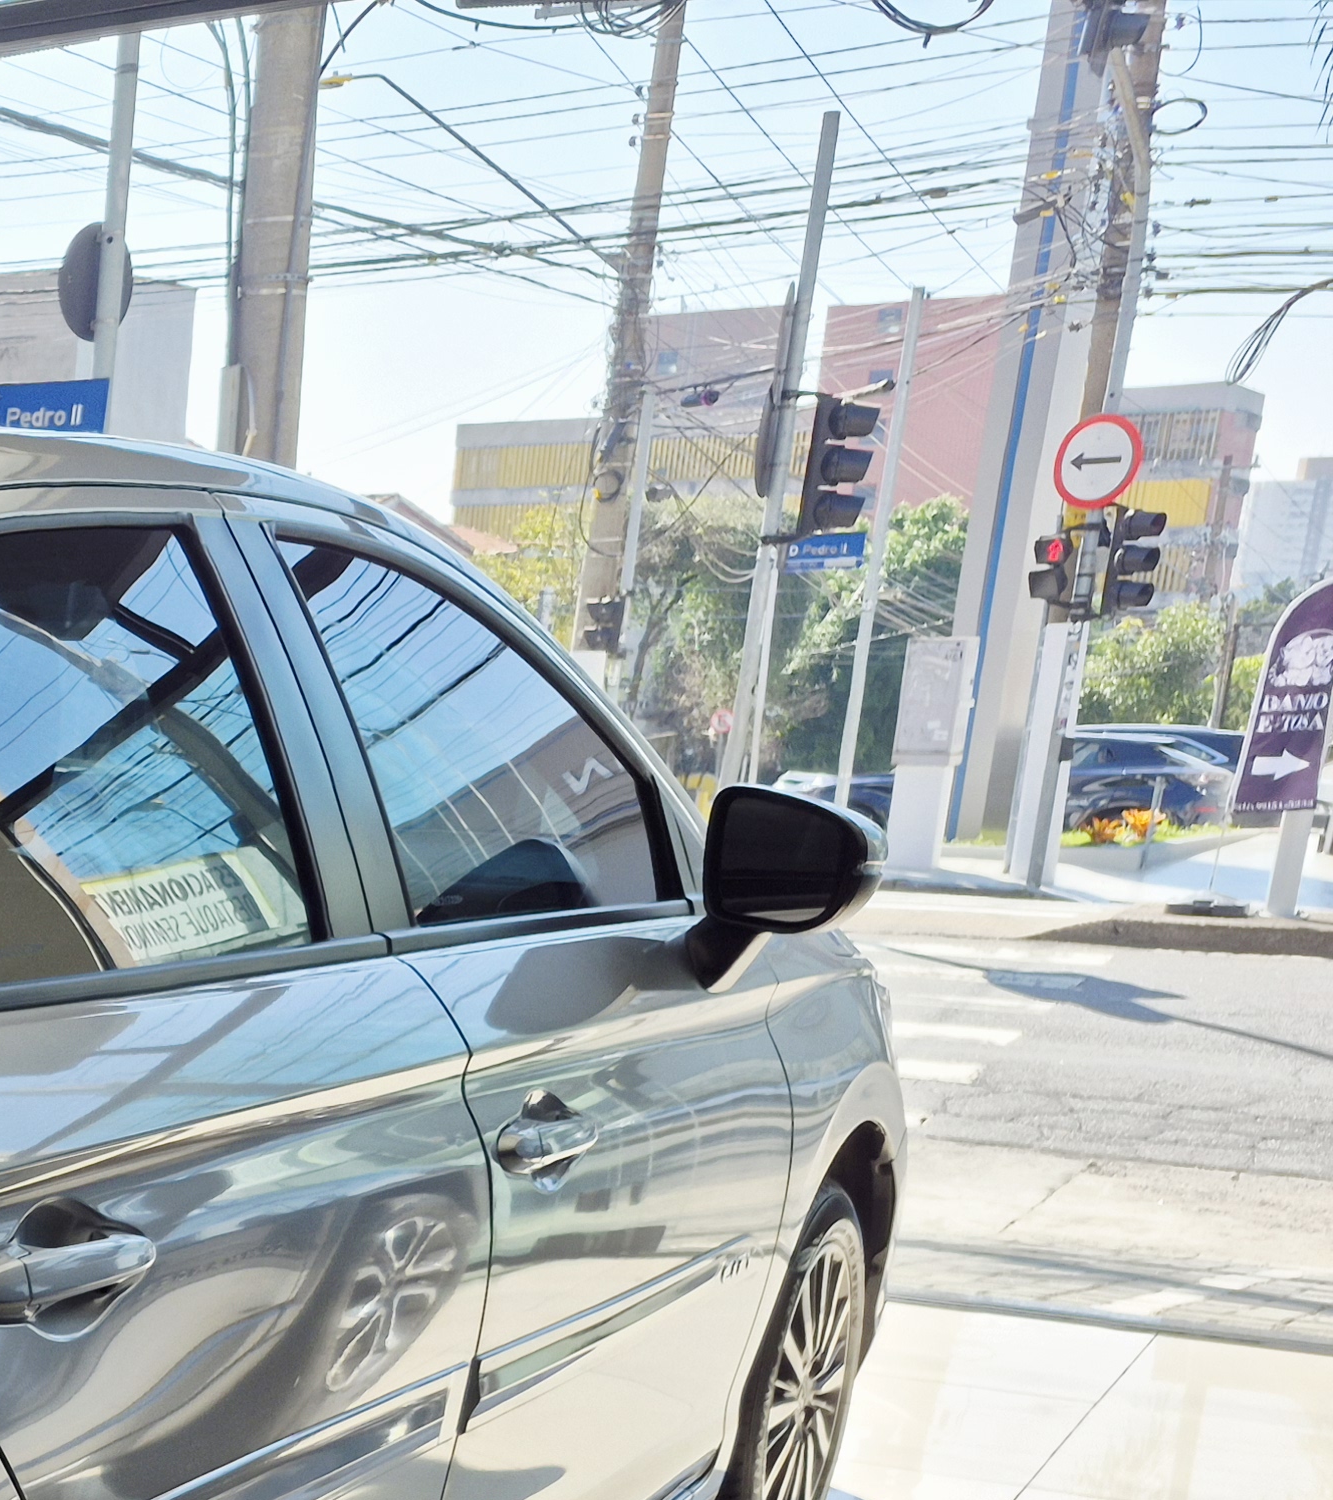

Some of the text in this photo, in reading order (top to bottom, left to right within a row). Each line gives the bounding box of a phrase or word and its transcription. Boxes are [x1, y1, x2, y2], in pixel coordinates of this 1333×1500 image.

[6, 407, 66, 427] Pedro
[70, 404, 83, 425] II
[803, 543, 838, 556] Pedro
